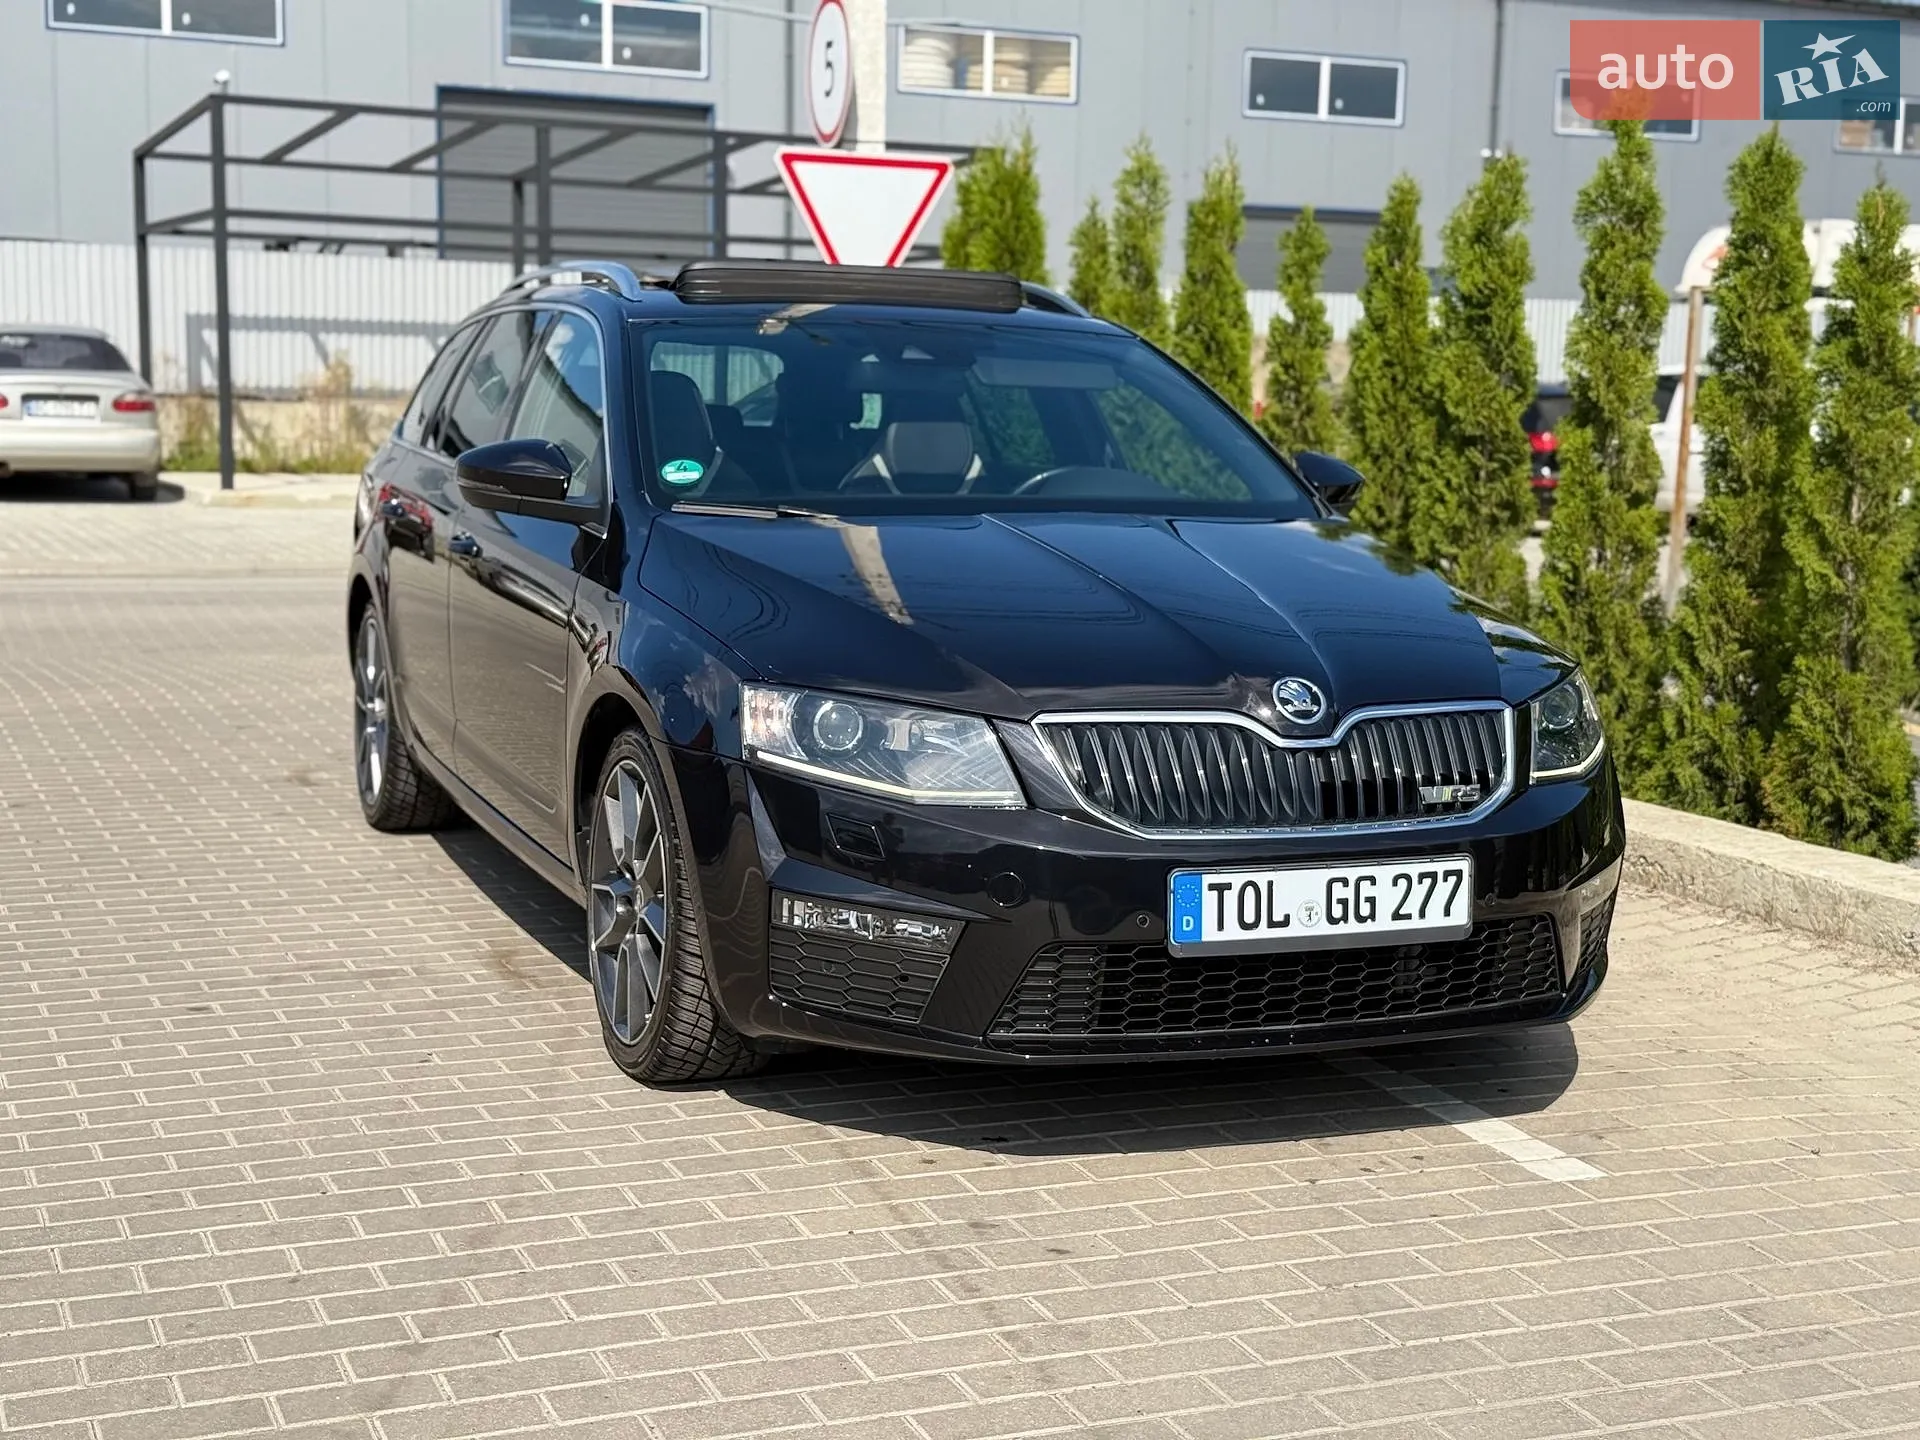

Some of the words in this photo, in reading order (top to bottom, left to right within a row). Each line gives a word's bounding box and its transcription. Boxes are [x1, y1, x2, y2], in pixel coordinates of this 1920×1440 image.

[824, 40, 834, 97] 5
[676, 461, 689, 472] 4
[1182, 915, 1195, 932] D
[1207, 879, 1291, 932] TOL
[1325, 875, 1377, 926] GG
[1390, 868, 1464, 922] 277
